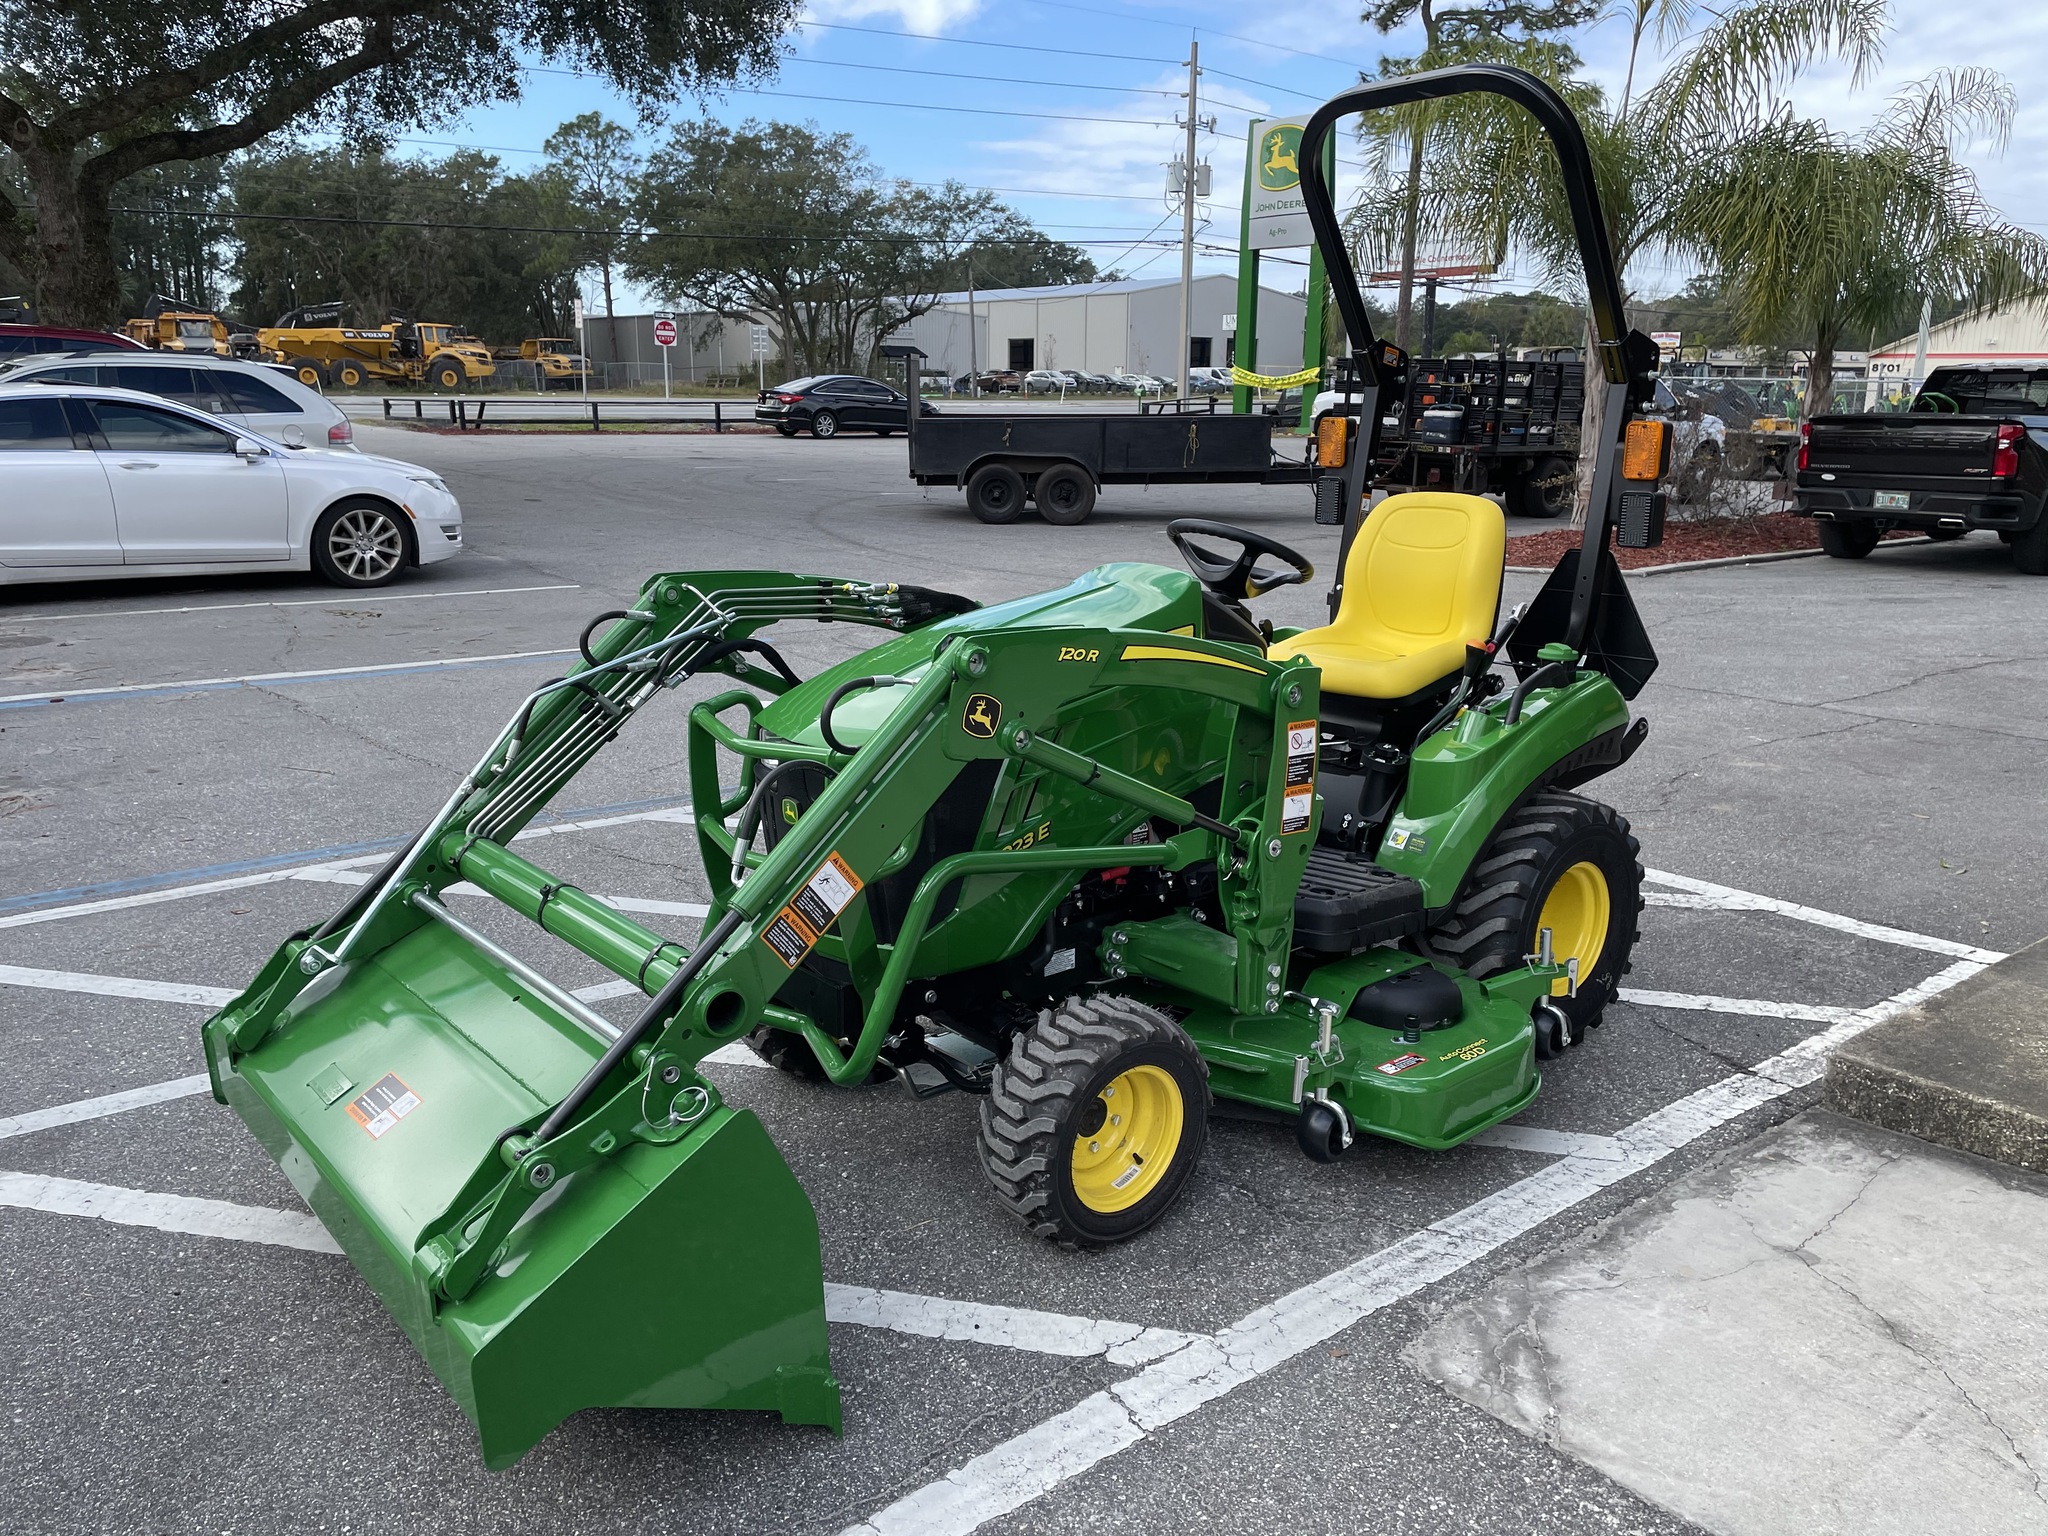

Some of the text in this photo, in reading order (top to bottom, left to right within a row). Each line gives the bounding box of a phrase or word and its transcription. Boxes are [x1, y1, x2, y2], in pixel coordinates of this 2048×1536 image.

[1255, 200, 1308, 212] JOHN DEERE
[1269, 228, 1287, 237] Ag-Pro
[312, 311, 338, 319] VOLVO
[1871, 363, 1901, 372] 8701
[1293, 720, 1316, 730] WARNING
[1289, 786, 1312, 796] WARNING
[837, 861, 860, 888] WARNING
[790, 917, 813, 943] WARNING
[1440, 1038, 1488, 1062] AutoConnect
[1459, 1046, 1487, 1061] 60D
